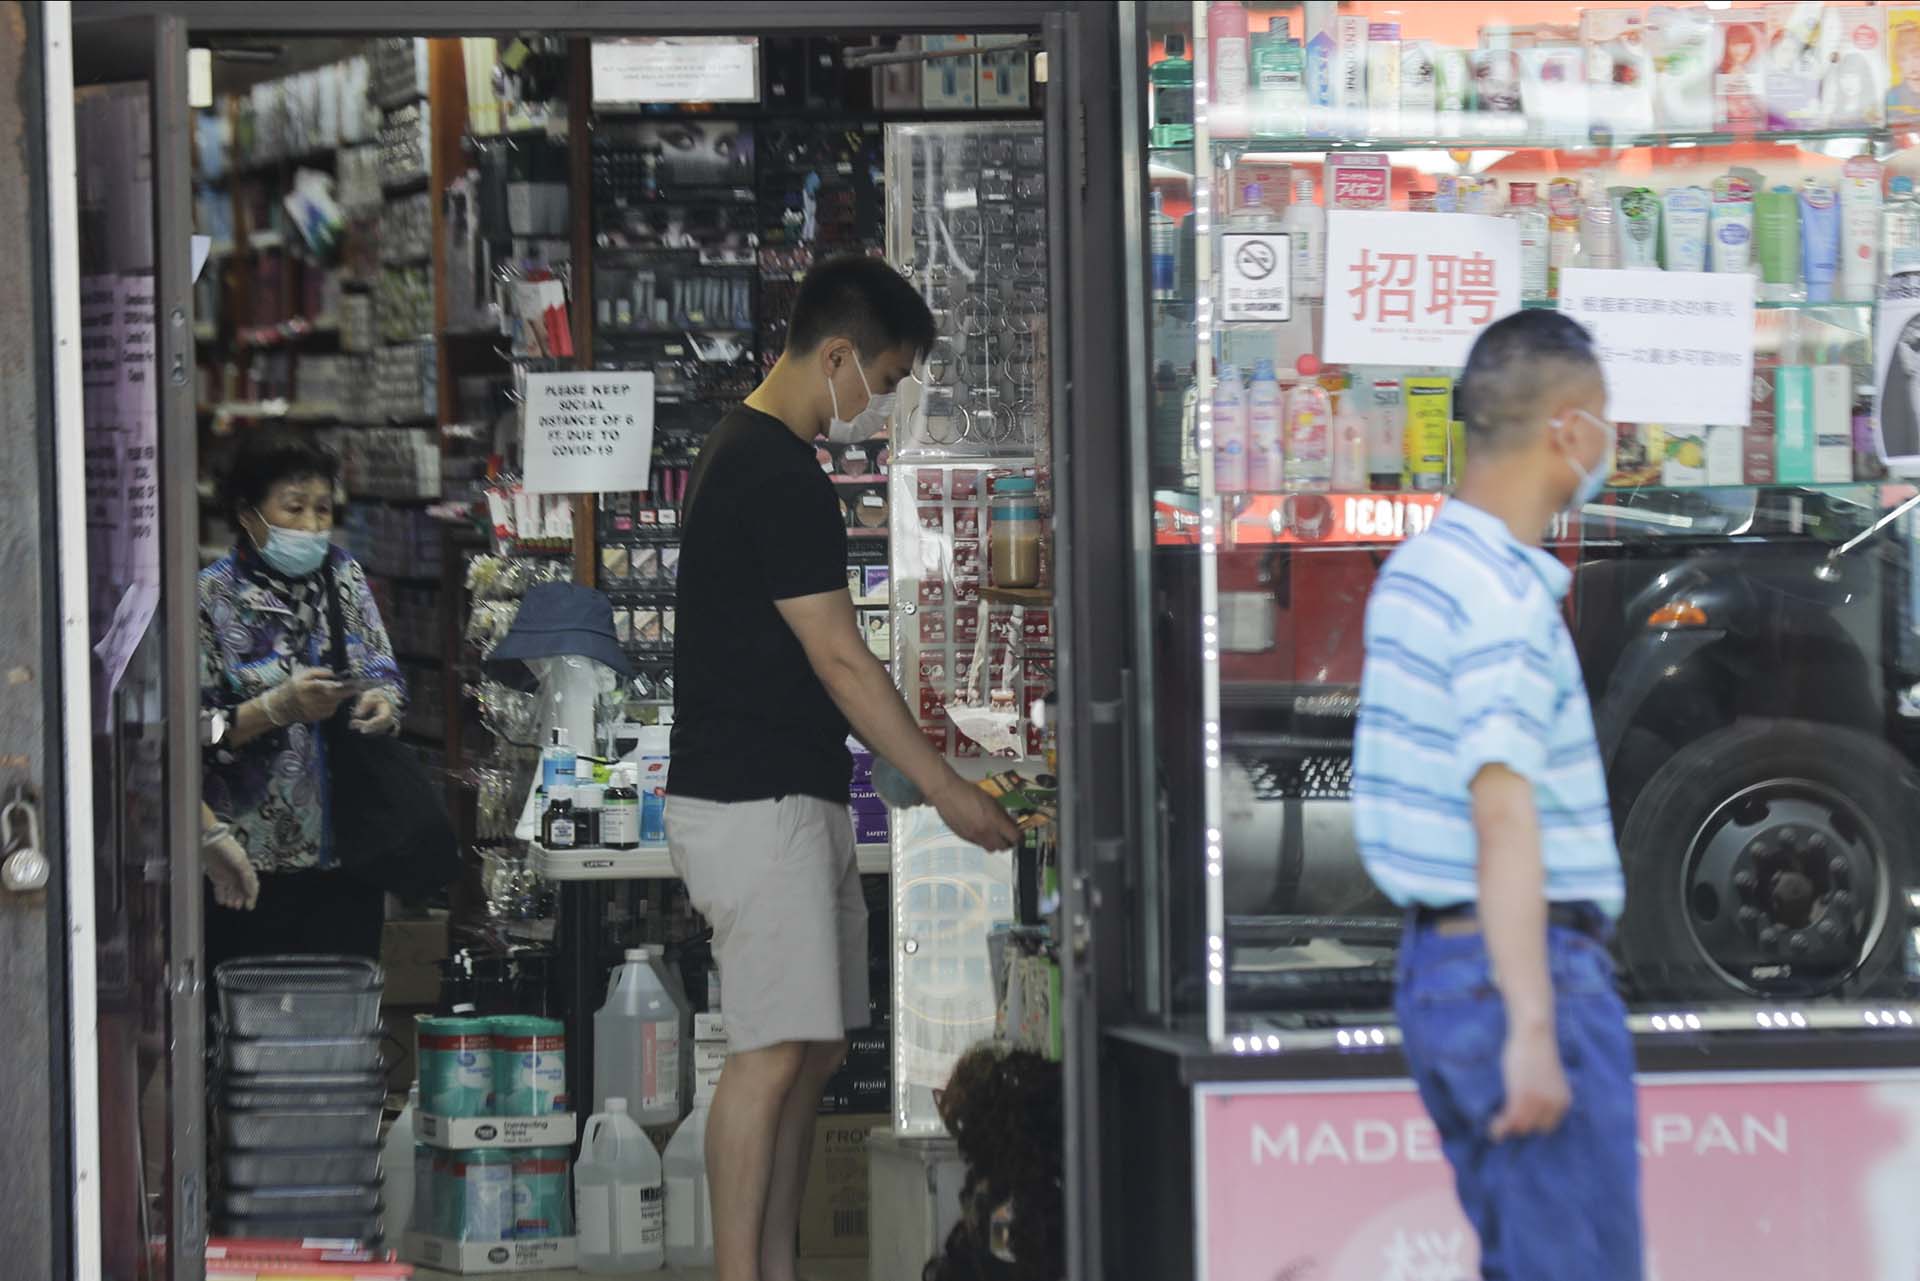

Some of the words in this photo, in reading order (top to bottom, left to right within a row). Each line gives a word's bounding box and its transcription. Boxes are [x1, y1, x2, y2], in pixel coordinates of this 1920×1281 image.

[1347, 248, 1499, 325] 招聘
[545, 384, 585, 396] PLEASE
[592, 384, 630, 395] KEEP
[559, 400, 604, 411] SOCIAL
[539, 415, 595, 427] DISTANCE
[602, 415, 619, 425] OF
[567, 430, 592, 441] DUE
[600, 430, 620, 440] TO
[551, 445, 613, 456] COVID-19
[852, 1041, 885, 1050] FROMM
[853, 1080, 887, 1089] FROMM
[825, 1129, 868, 1144] FRO
[1251, 1118, 1443, 1167] MADE
[1635, 1113, 1788, 1157] PAN
